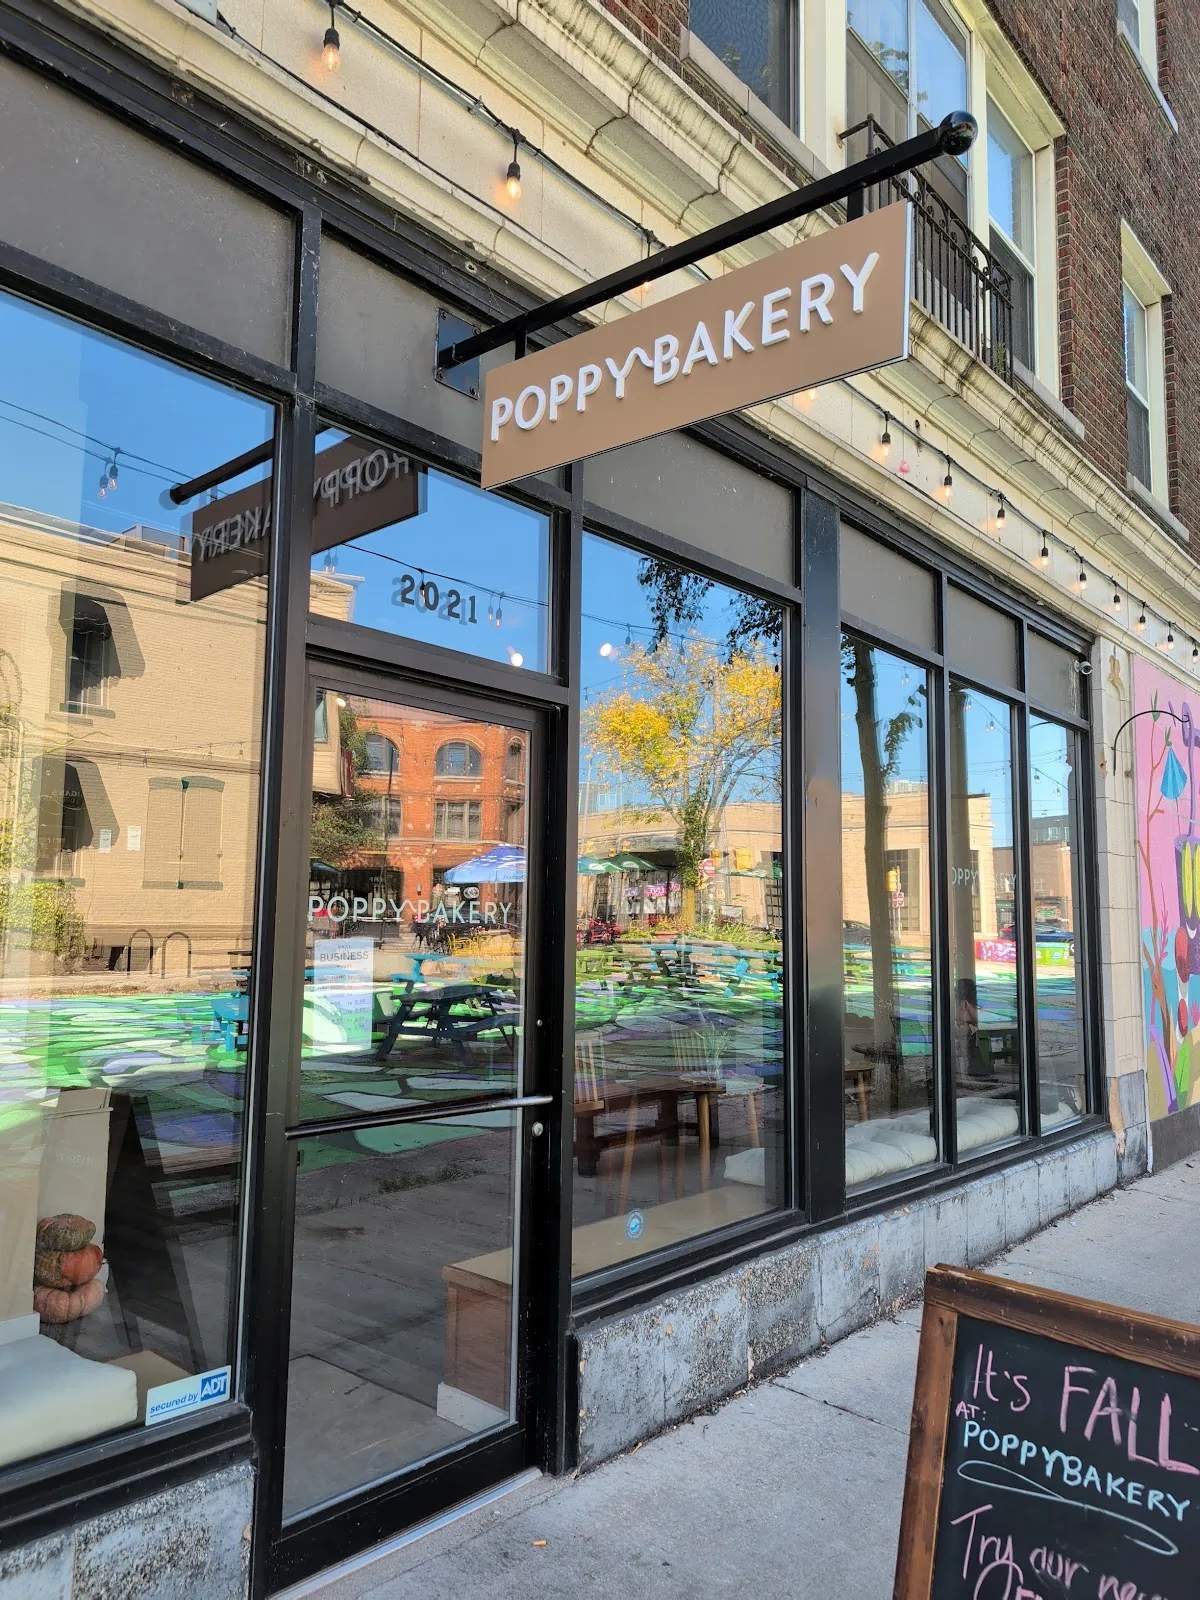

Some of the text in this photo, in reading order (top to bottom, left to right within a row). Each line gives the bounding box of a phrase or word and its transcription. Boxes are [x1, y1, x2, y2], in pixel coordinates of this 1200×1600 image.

[400, 574, 477, 624] 2021
[320, 951, 369, 962] BUSINESS
[150, 1376, 227, 1414] secured by ADT
[1059, 1365, 1200, 1476] FALL
